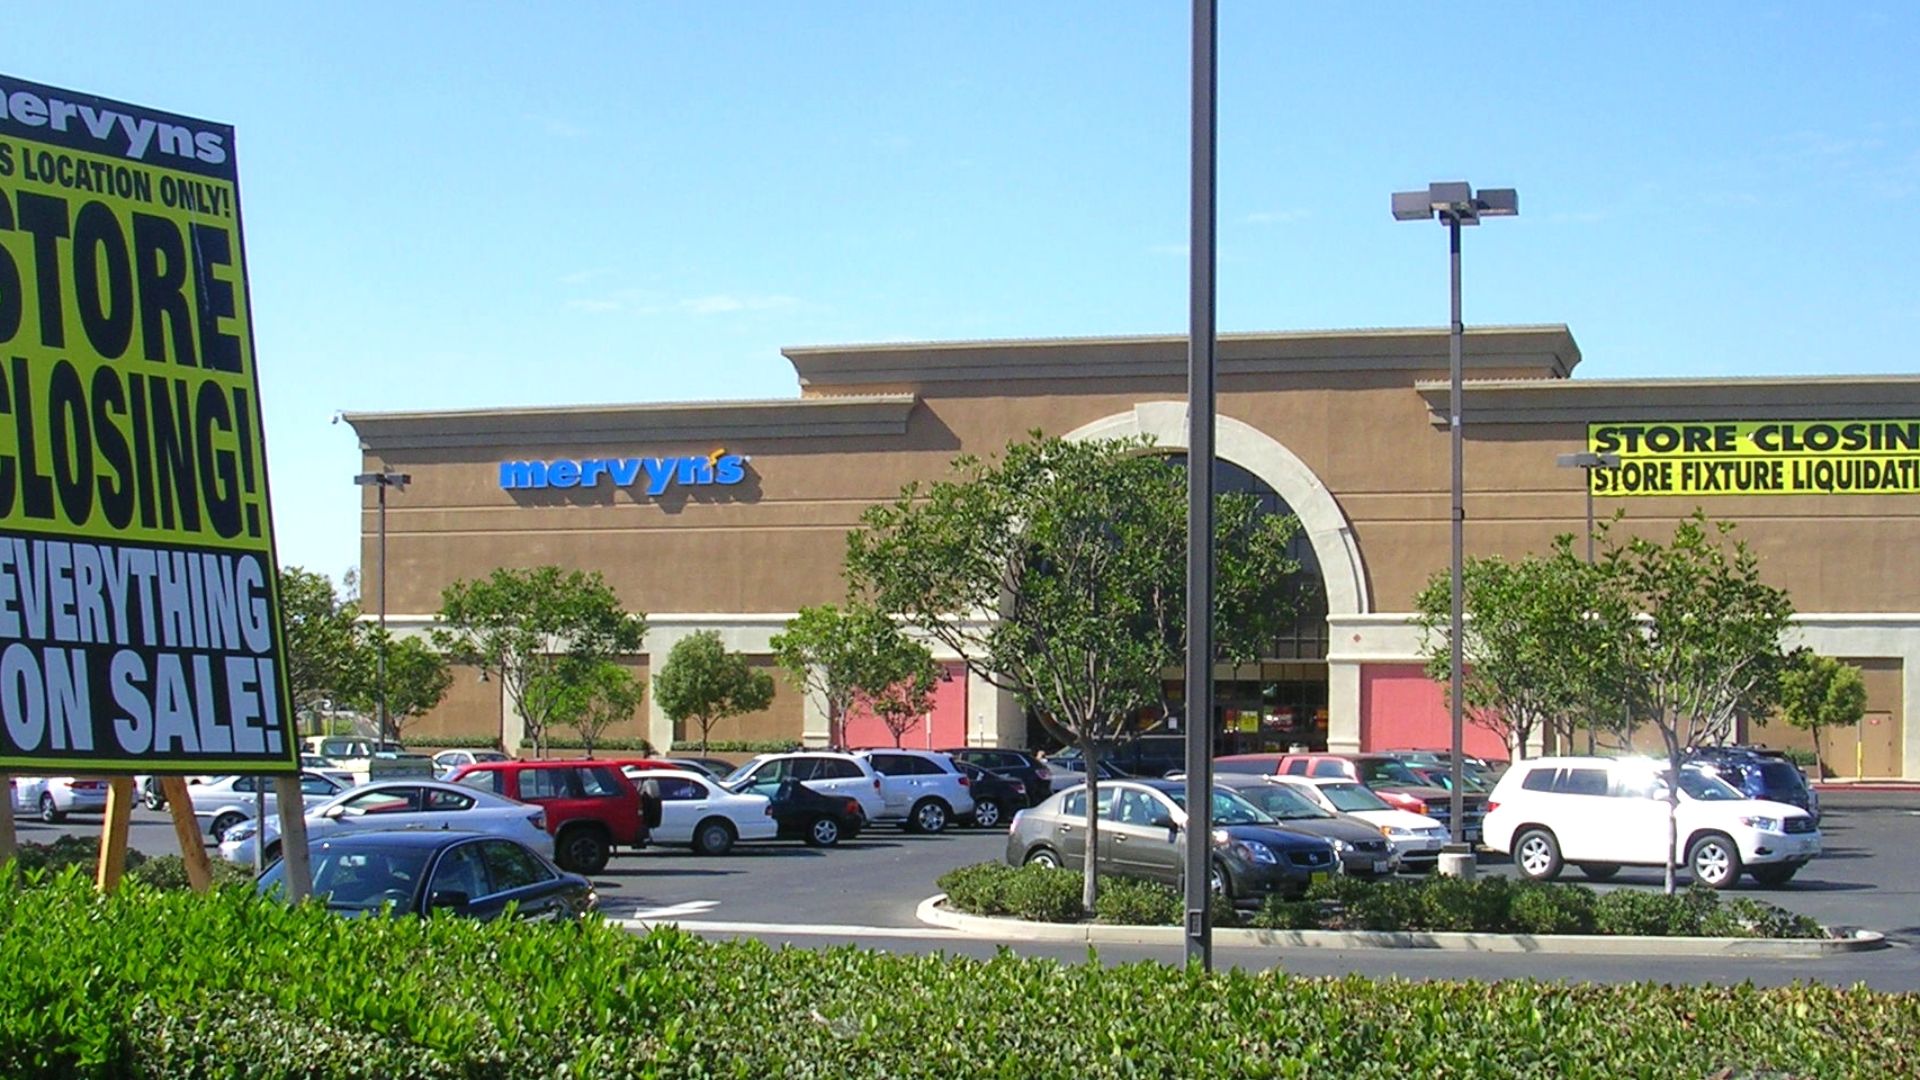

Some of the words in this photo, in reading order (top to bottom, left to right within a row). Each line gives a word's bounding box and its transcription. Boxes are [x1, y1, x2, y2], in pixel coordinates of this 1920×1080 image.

[0, 89, 226, 164] ervyns
[22, 147, 152, 203] LOCATION
[160, 175, 231, 218] ONLY!
[499, 448, 745, 495] mervyn's
[1595, 424, 1737, 453] STORE
[1753, 422, 1920, 452] CLOSIN
[1594, 461, 1673, 491] STORE
[1681, 460, 1784, 491] FIXTURE
[1792, 458, 1920, 492] LIQUIDATI
[0, 537, 272, 653] EVERYTHING
[0, 643, 94, 751] ON
[110, 650, 283, 755] SALE!
